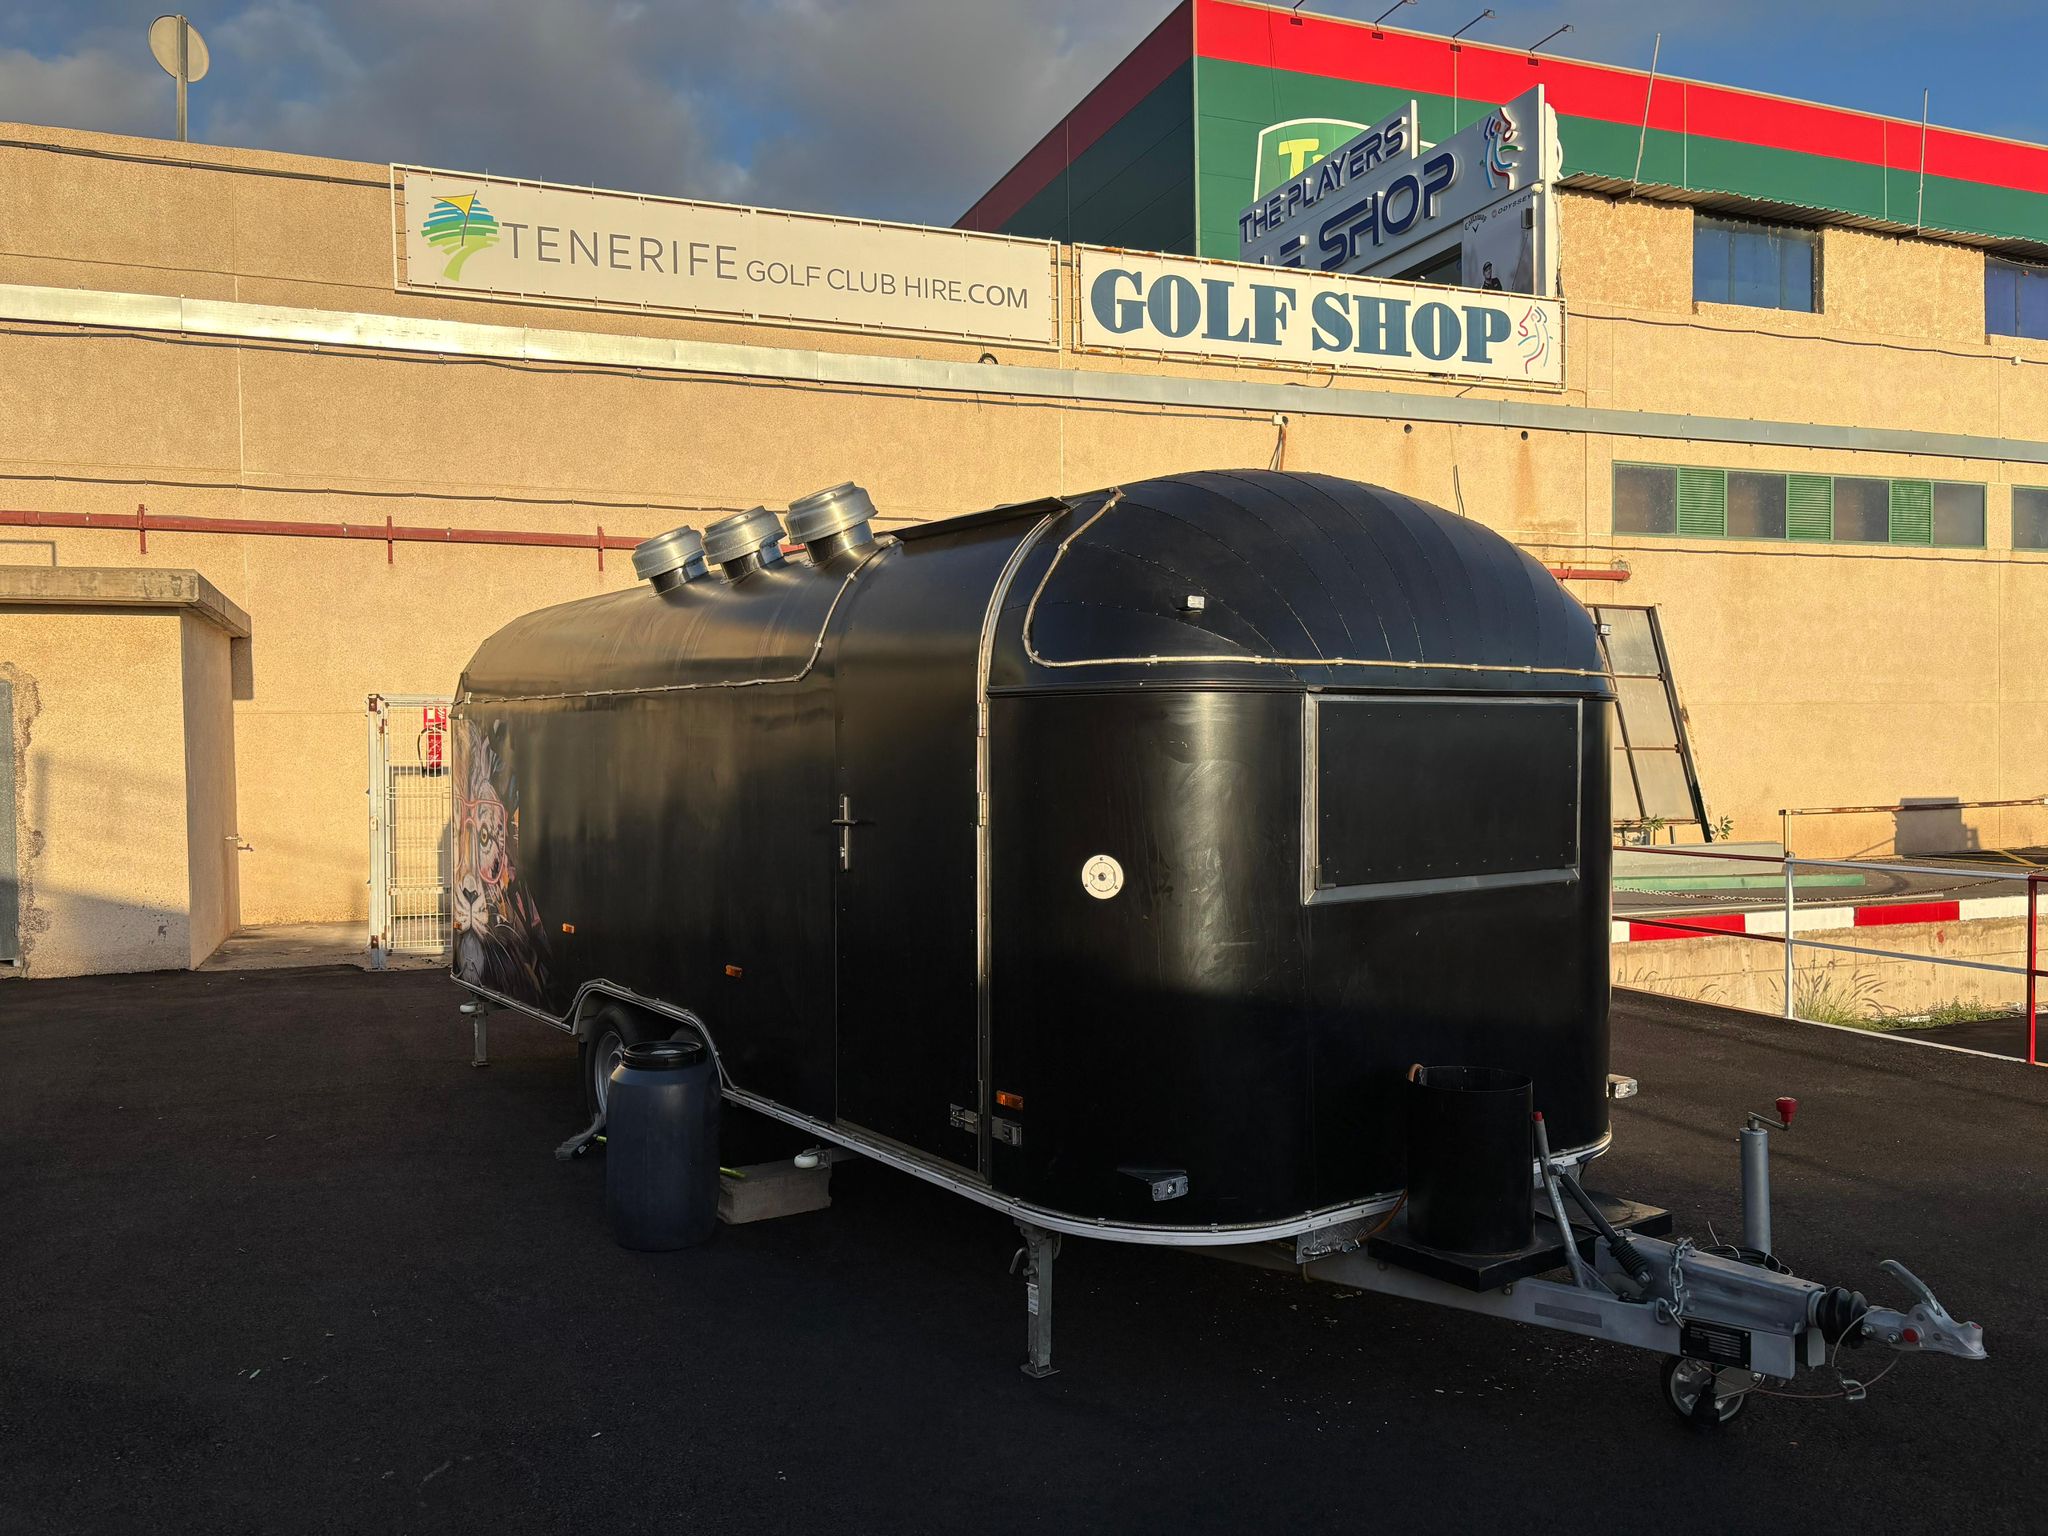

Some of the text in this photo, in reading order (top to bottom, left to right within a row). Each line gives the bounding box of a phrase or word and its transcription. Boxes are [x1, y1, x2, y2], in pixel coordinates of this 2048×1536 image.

[1239, 116, 1409, 244] THE PLAYERS
[1319, 152, 1457, 271] SHOP
[501, 222, 1029, 309] TENERIFE GOLF CLUB HIRE.COM
[1090, 268, 1512, 364] GOLF SHOP
